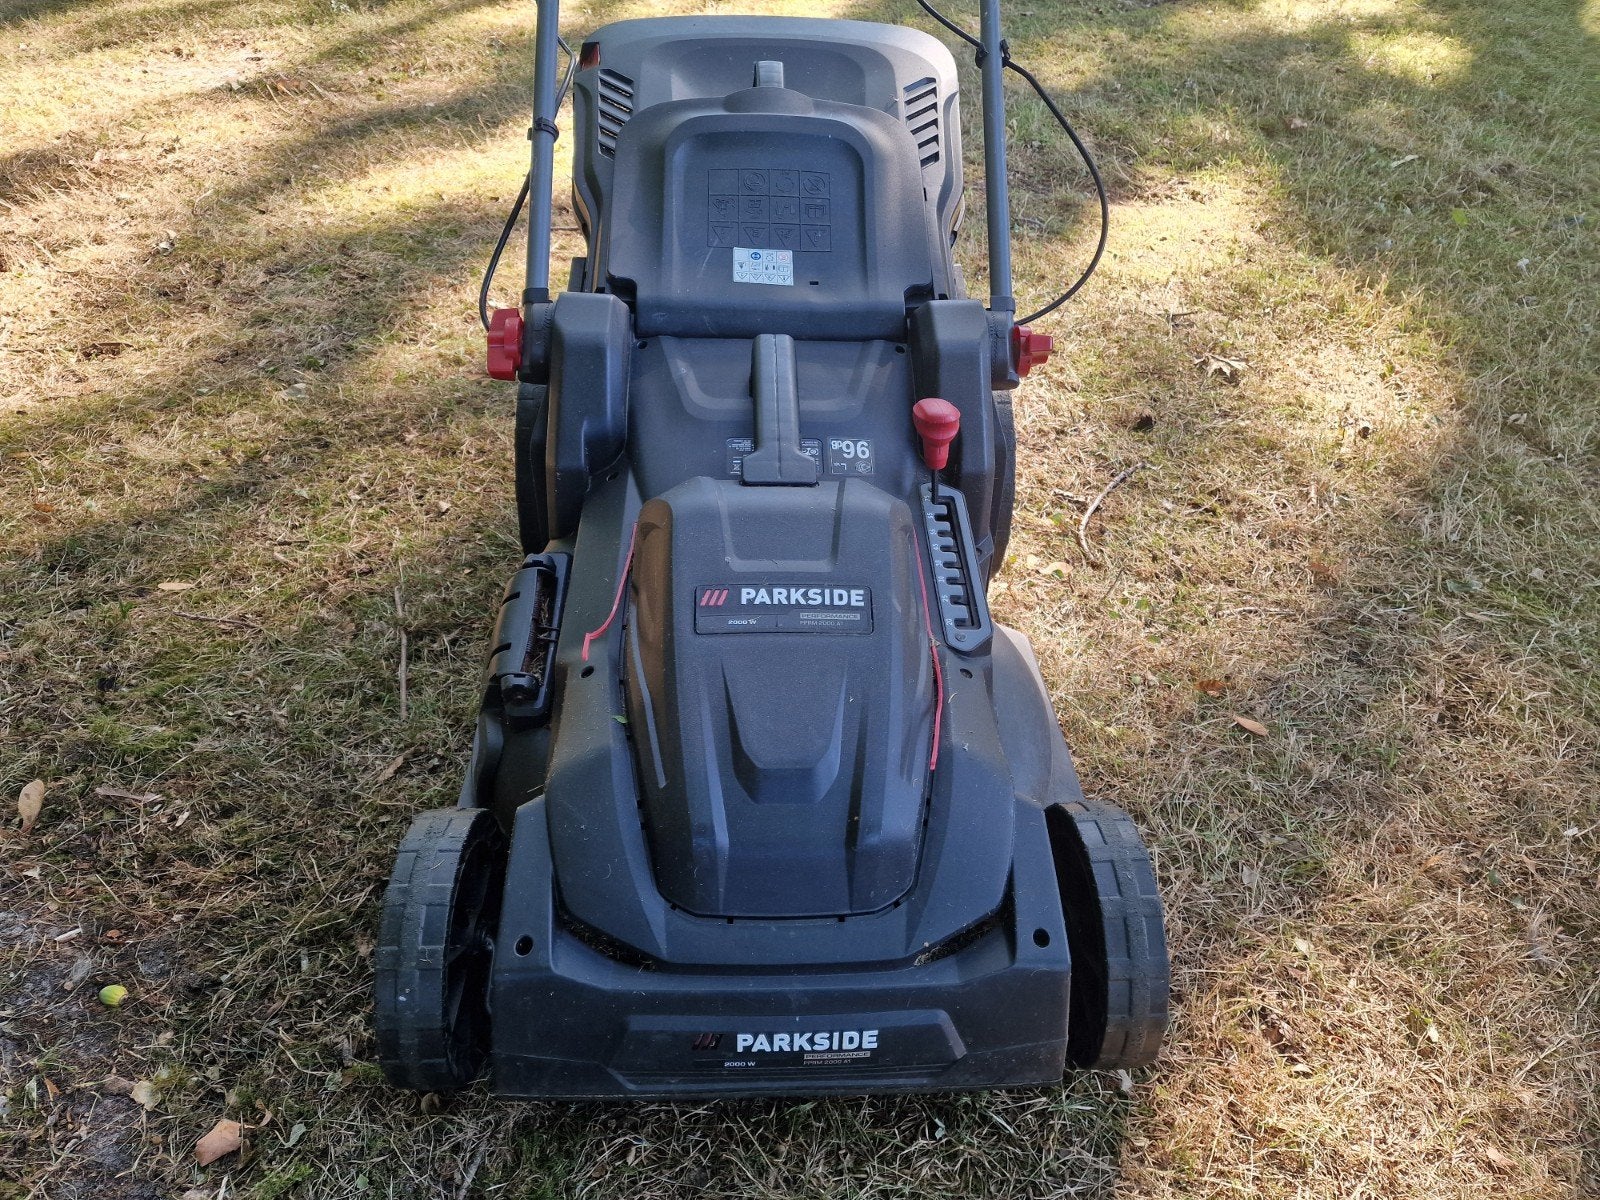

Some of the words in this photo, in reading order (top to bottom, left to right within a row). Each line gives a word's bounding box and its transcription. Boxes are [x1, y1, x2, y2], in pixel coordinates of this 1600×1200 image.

[741, 588, 865, 607] PARKSIDE
[946, 618, 953, 626] 20
[736, 1030, 879, 1052] PARKSIDE
[804, 1051, 870, 1060] PERFORMANCE
